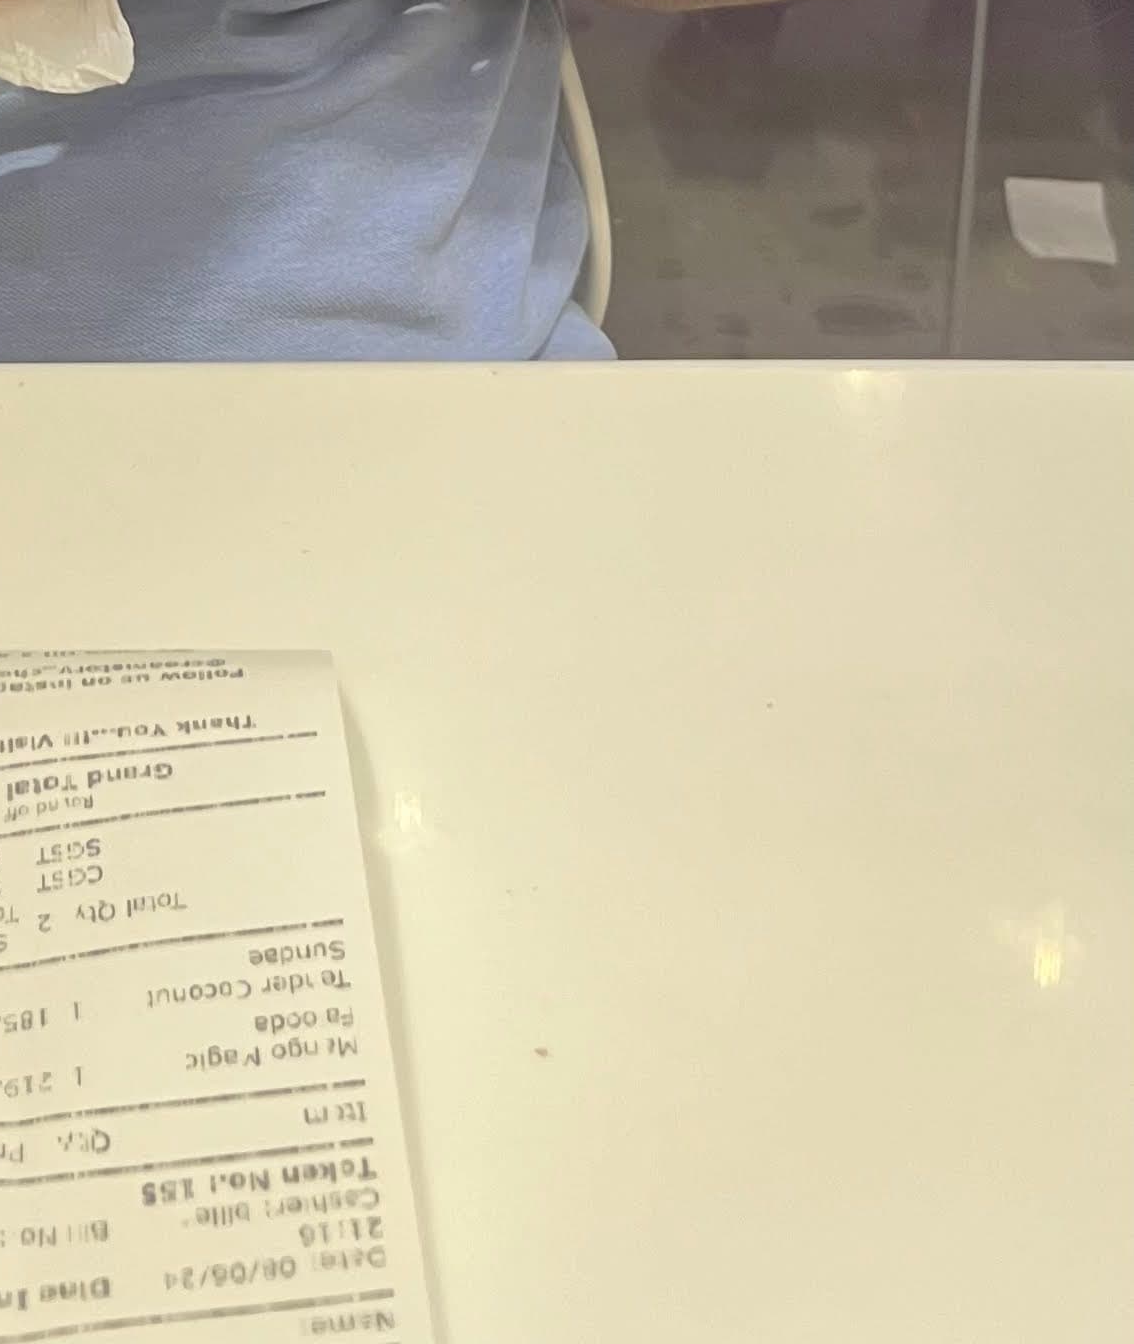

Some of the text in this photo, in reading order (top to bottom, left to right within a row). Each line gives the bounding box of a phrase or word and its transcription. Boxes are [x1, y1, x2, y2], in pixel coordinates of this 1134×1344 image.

[81, 675, 112, 689] on
[161, 668, 244, 683] Follow
[176, 715, 257, 736] Thank
[6, 774, 78, 801] Total
[87, 762, 173, 789] Grand
[38, 892, 187, 933] Total Qty 2
[248, 939, 346, 967] Sundae
[147, 979, 253, 1009] Coconut
[282, 1157, 378, 1186] Token
